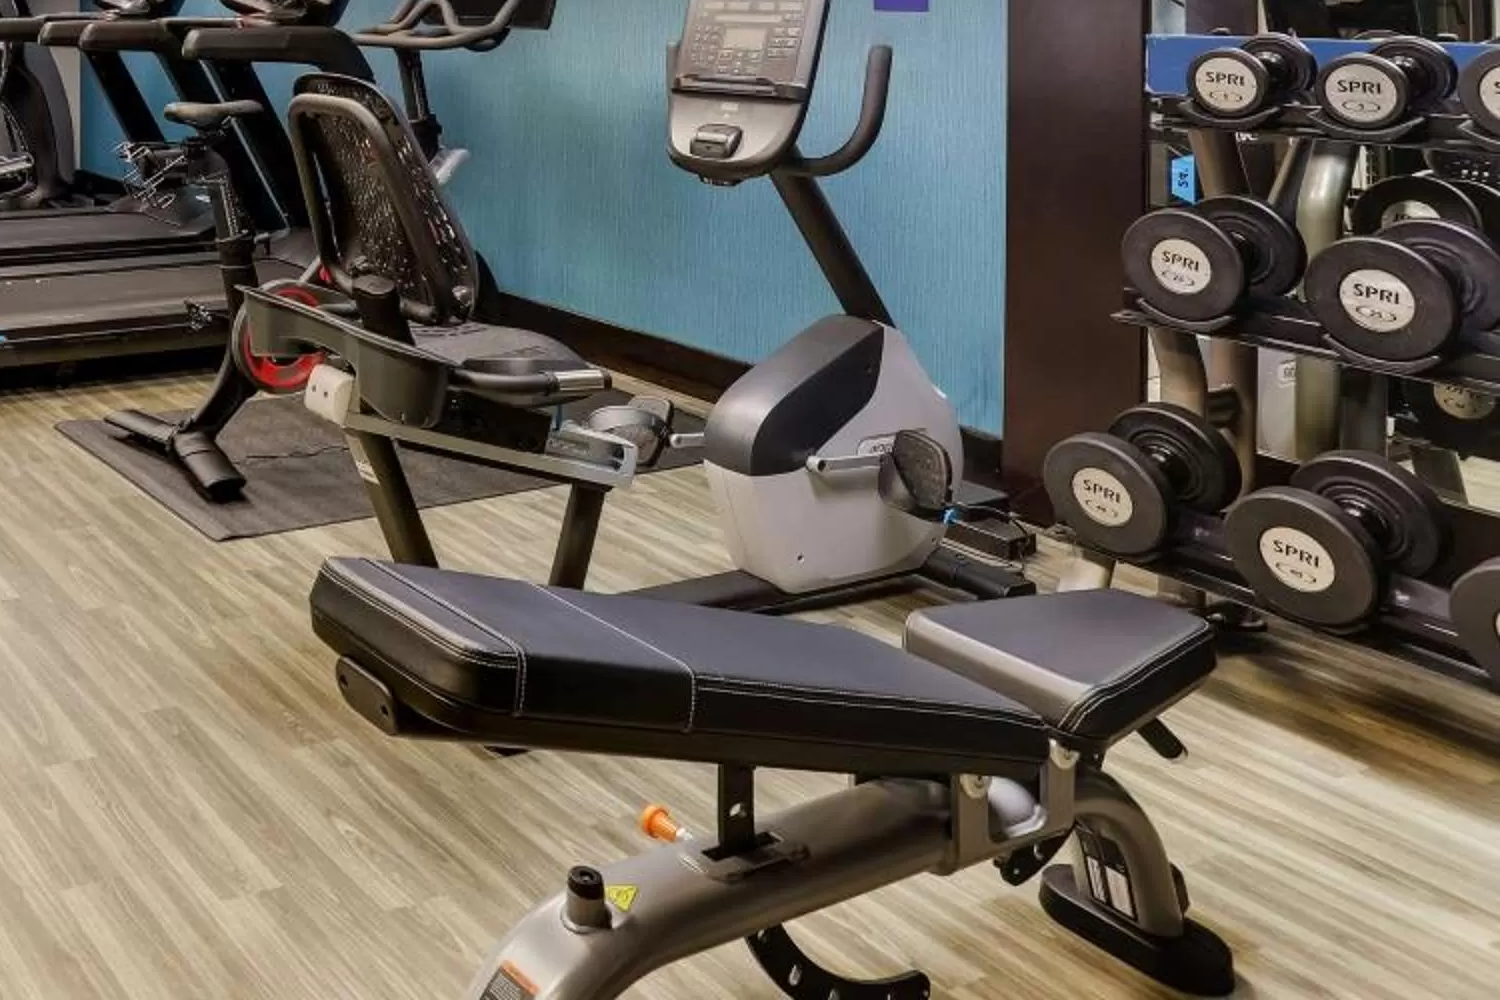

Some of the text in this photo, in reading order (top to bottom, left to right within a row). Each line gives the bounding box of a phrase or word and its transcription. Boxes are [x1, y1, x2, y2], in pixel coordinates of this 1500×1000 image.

[1205, 71, 1245, 87] SPRI
[1337, 79, 1382, 95] SPRI
[1160, 251, 1200, 273] SPRI
[1352, 283, 1400, 305] SPRI
[1082, 479, 1122, 504] SPRI
[1272, 539, 1320, 568] SPRI
